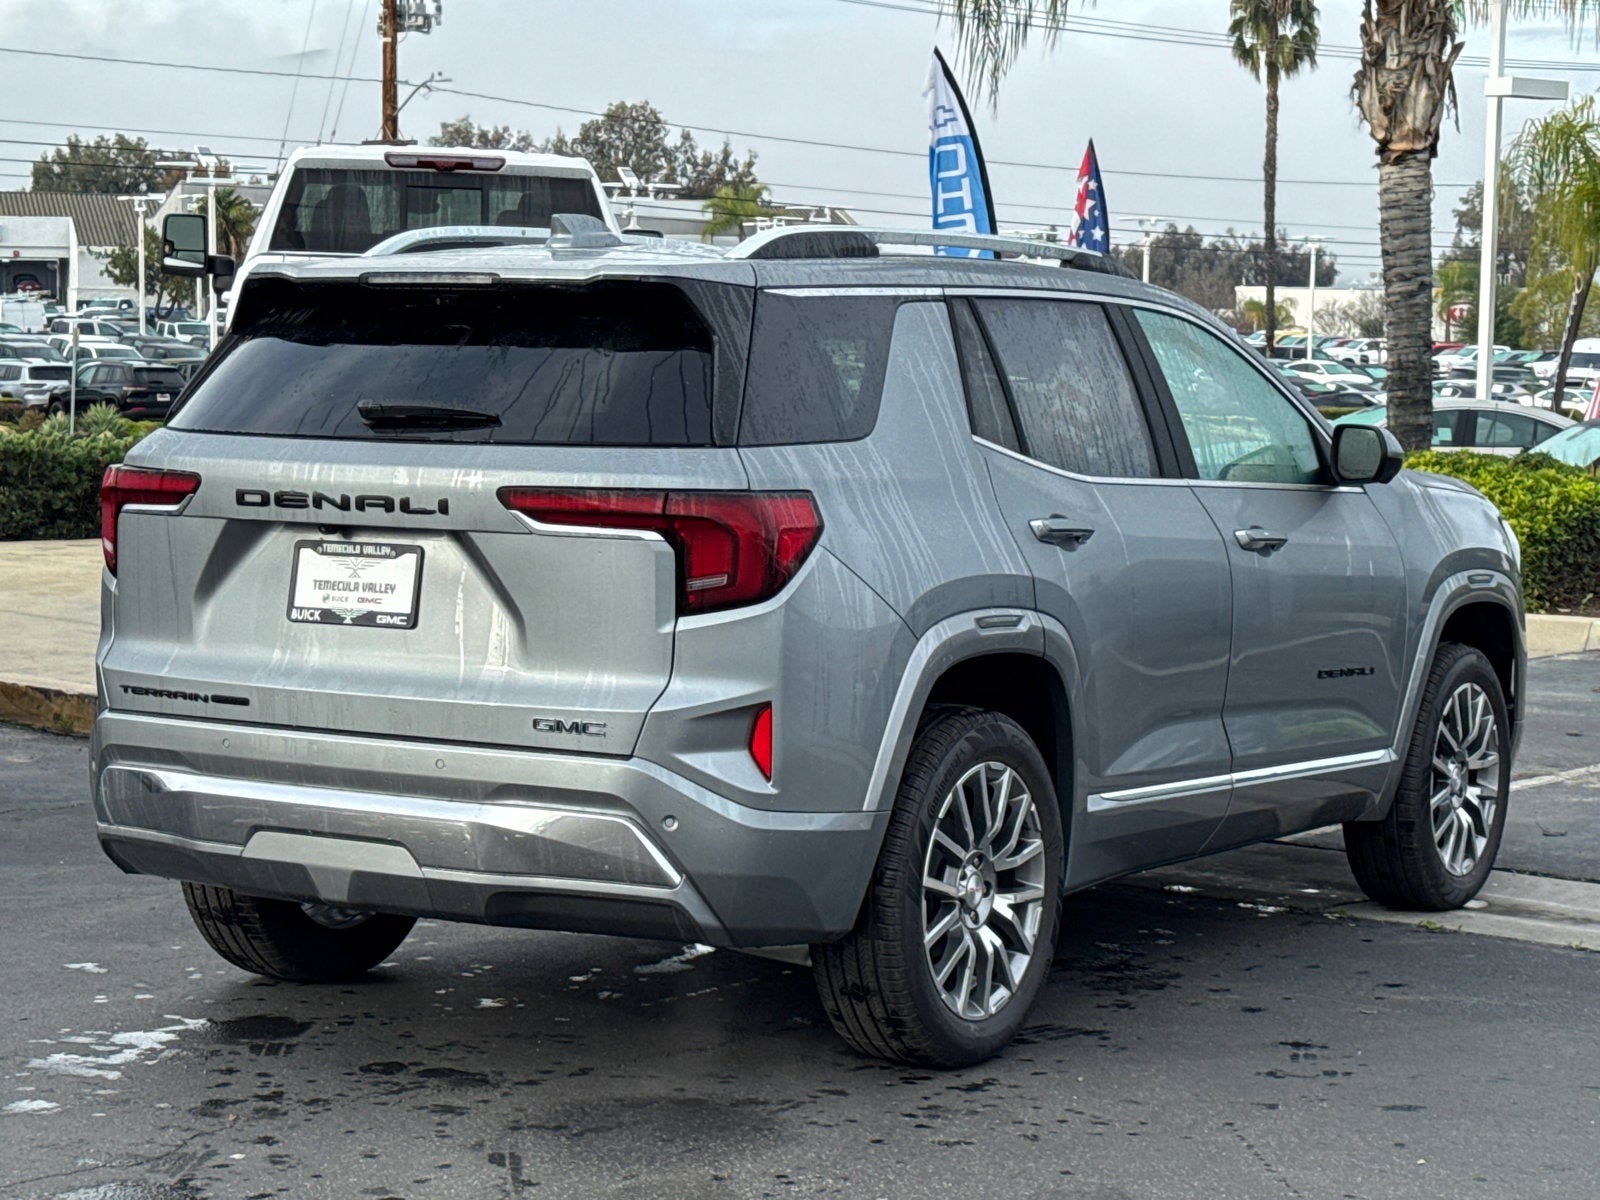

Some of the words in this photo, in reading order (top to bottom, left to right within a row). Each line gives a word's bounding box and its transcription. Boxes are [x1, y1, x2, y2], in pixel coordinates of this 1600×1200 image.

[236, 489, 449, 516] DENALI
[322, 543, 361, 554] TEMECULA
[362, 545, 391, 556] VALLEY
[313, 579, 359, 592] TEMECULA
[362, 582, 396, 595] VALLEY
[357, 596, 383, 605] GMC
[290, 608, 322, 621] BUICK
[376, 614, 407, 626] GMC
[1317, 667, 1374, 679] DENALI
[119, 684, 209, 704] TERRAIN
[532, 717, 607, 738] GMC
